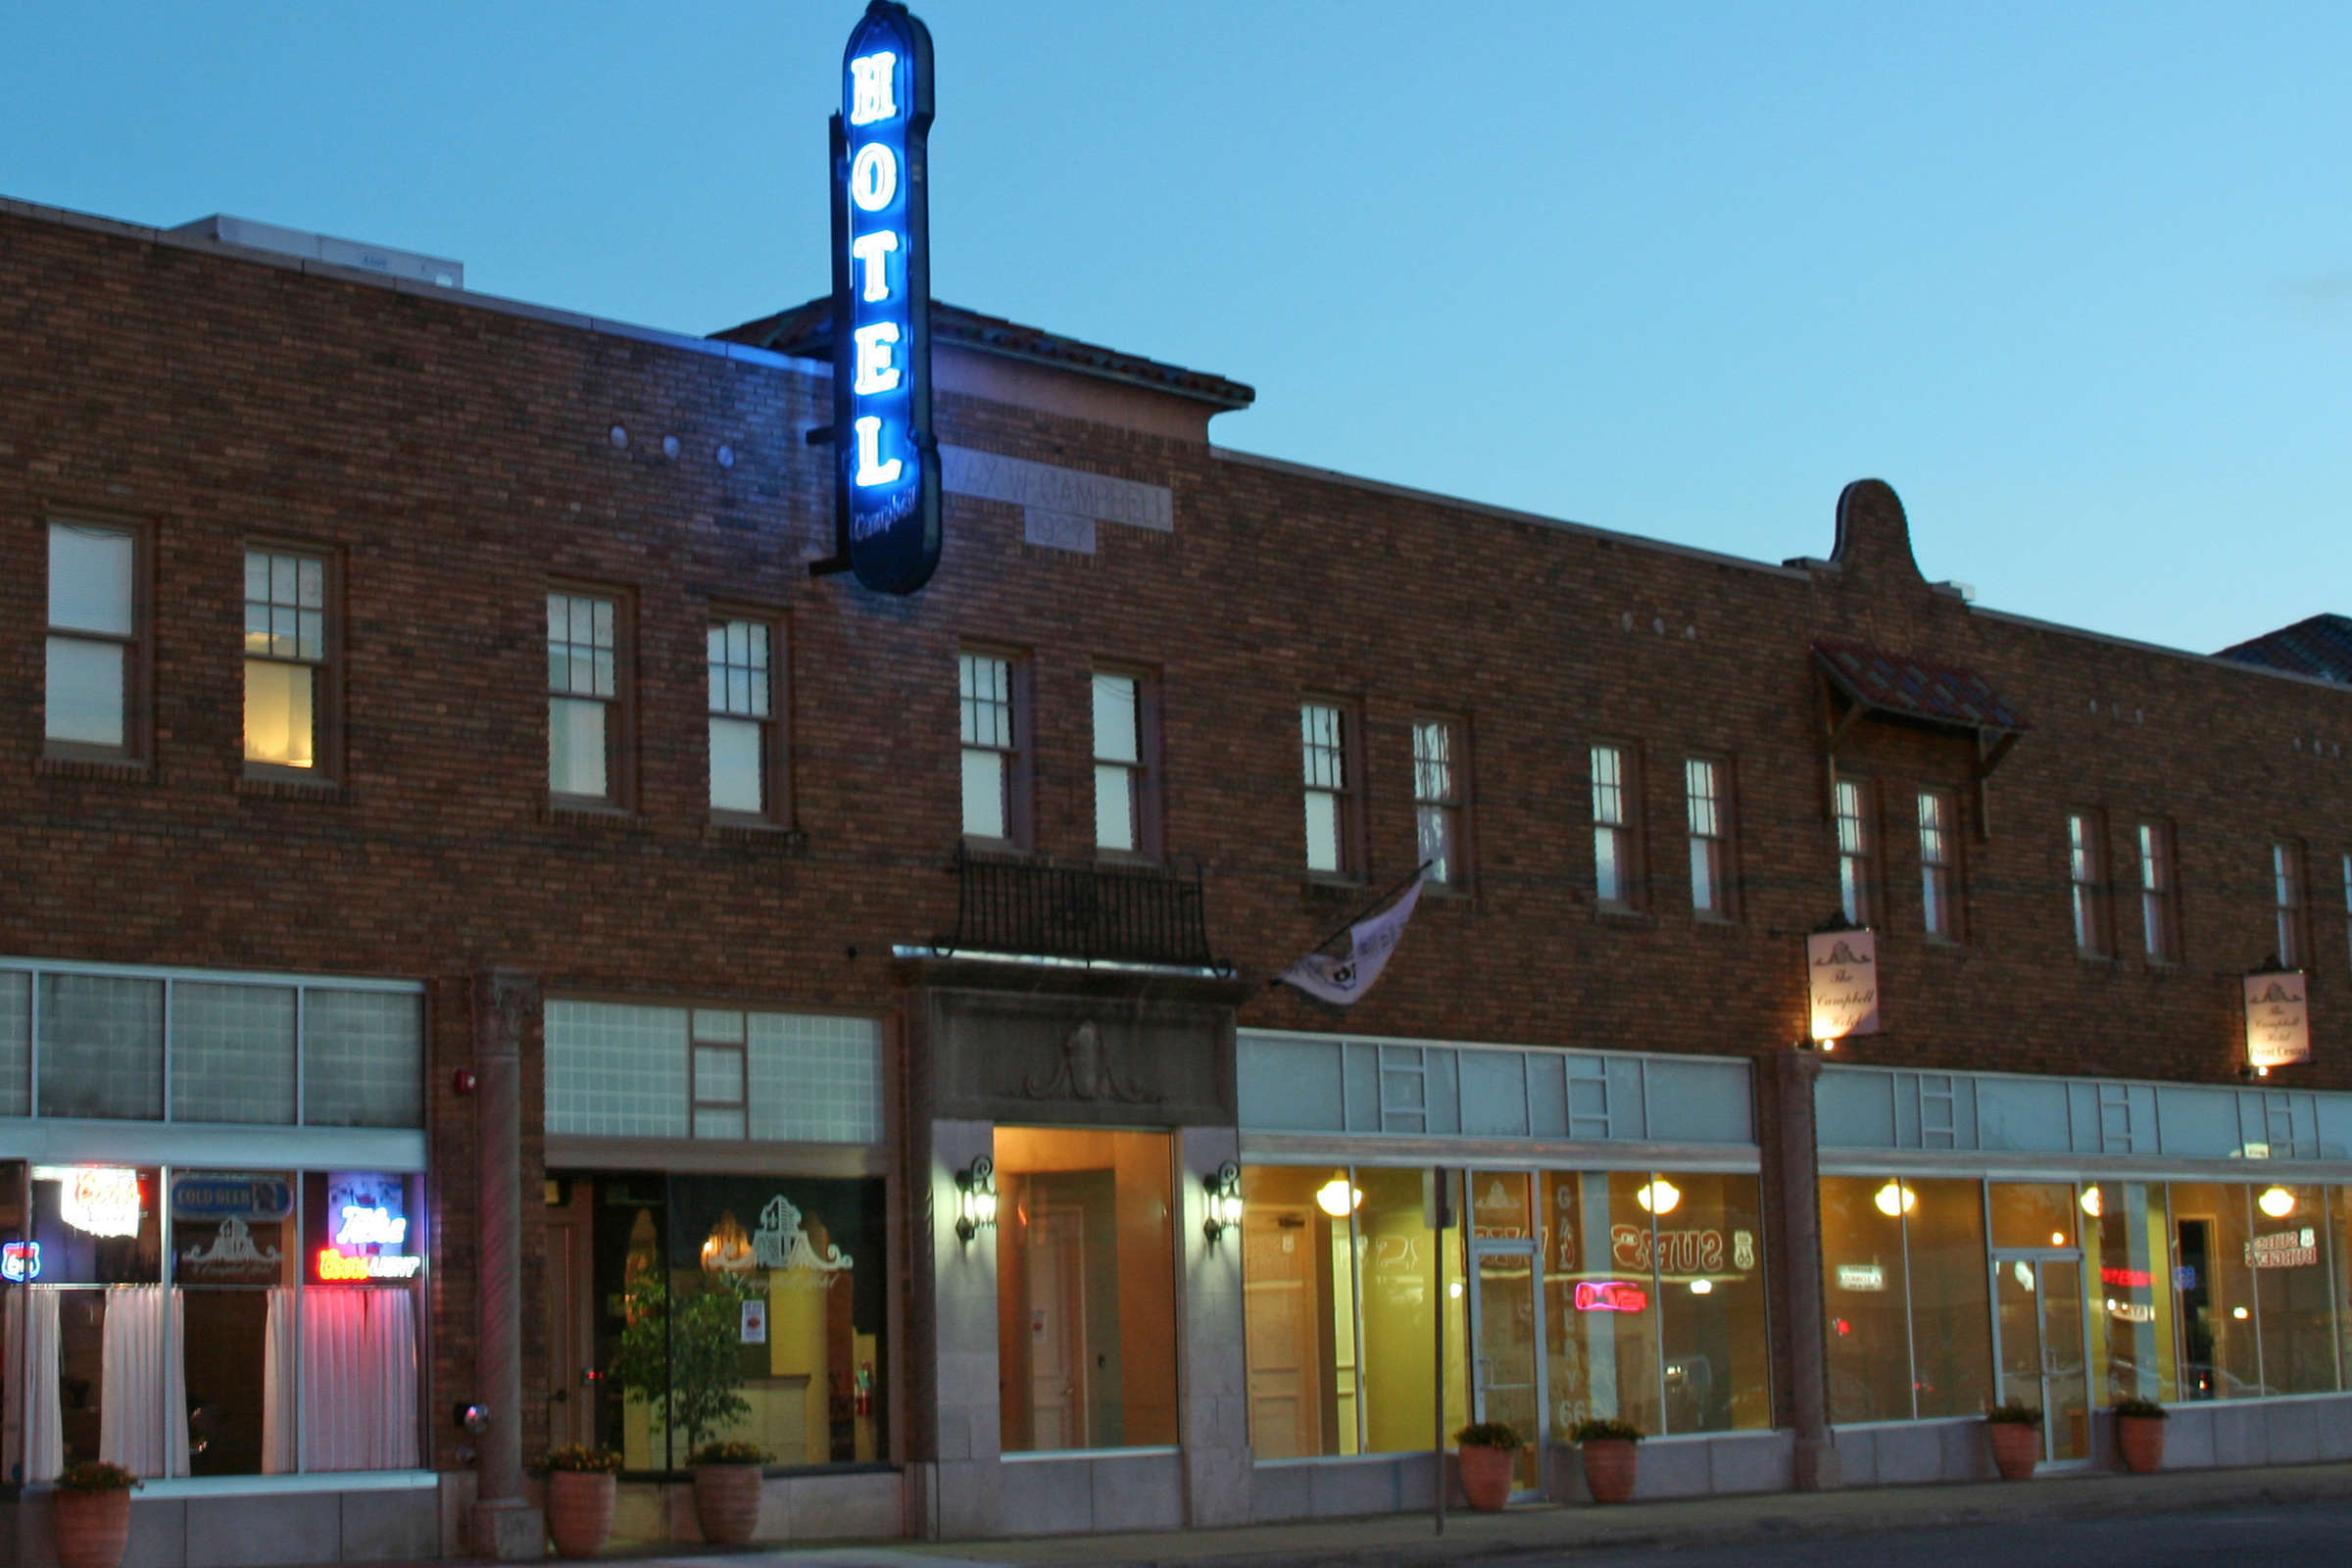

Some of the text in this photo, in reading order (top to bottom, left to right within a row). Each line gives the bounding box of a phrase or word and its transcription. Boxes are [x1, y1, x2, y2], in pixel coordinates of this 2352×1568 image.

[850, 51, 902, 487] HOTEL
[1817, 989, 1876, 1010] Campbell
[177, 1189, 250, 1206] COLD BEER
